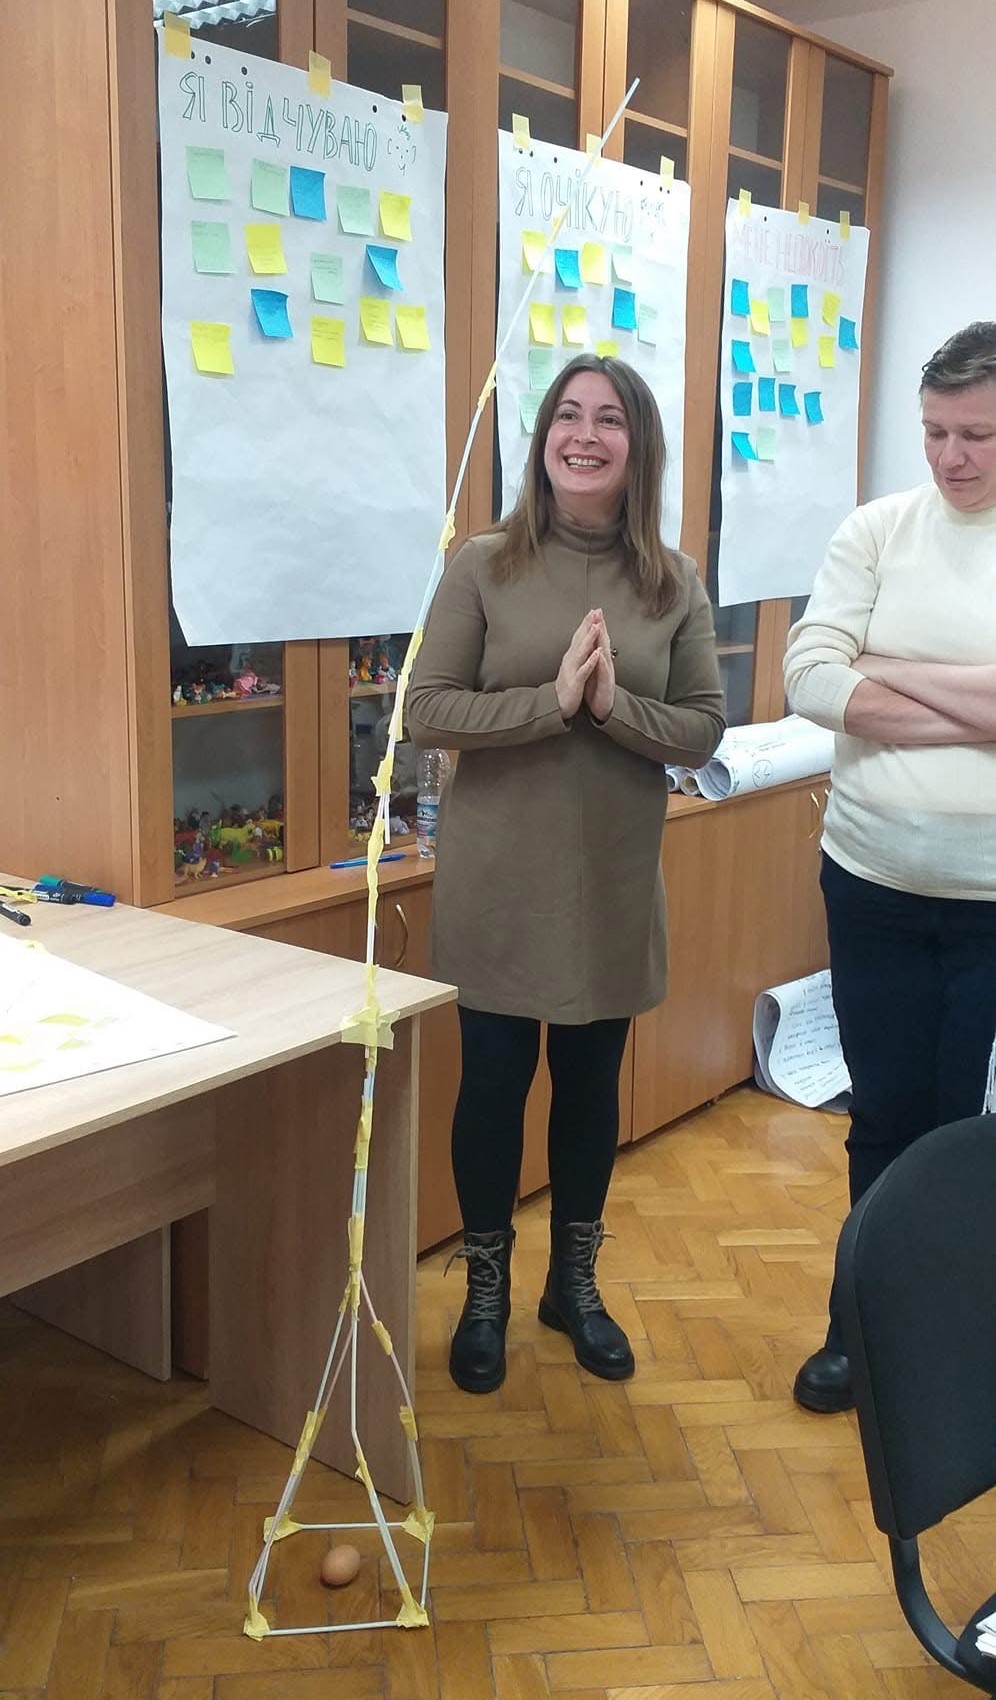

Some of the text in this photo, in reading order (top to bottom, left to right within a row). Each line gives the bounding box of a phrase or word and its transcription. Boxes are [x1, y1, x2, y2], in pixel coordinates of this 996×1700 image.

[179, 71, 378, 171] Я ВІДЧУВАЮ
[515, 167, 633, 243] Я ОЧІКУЮ
